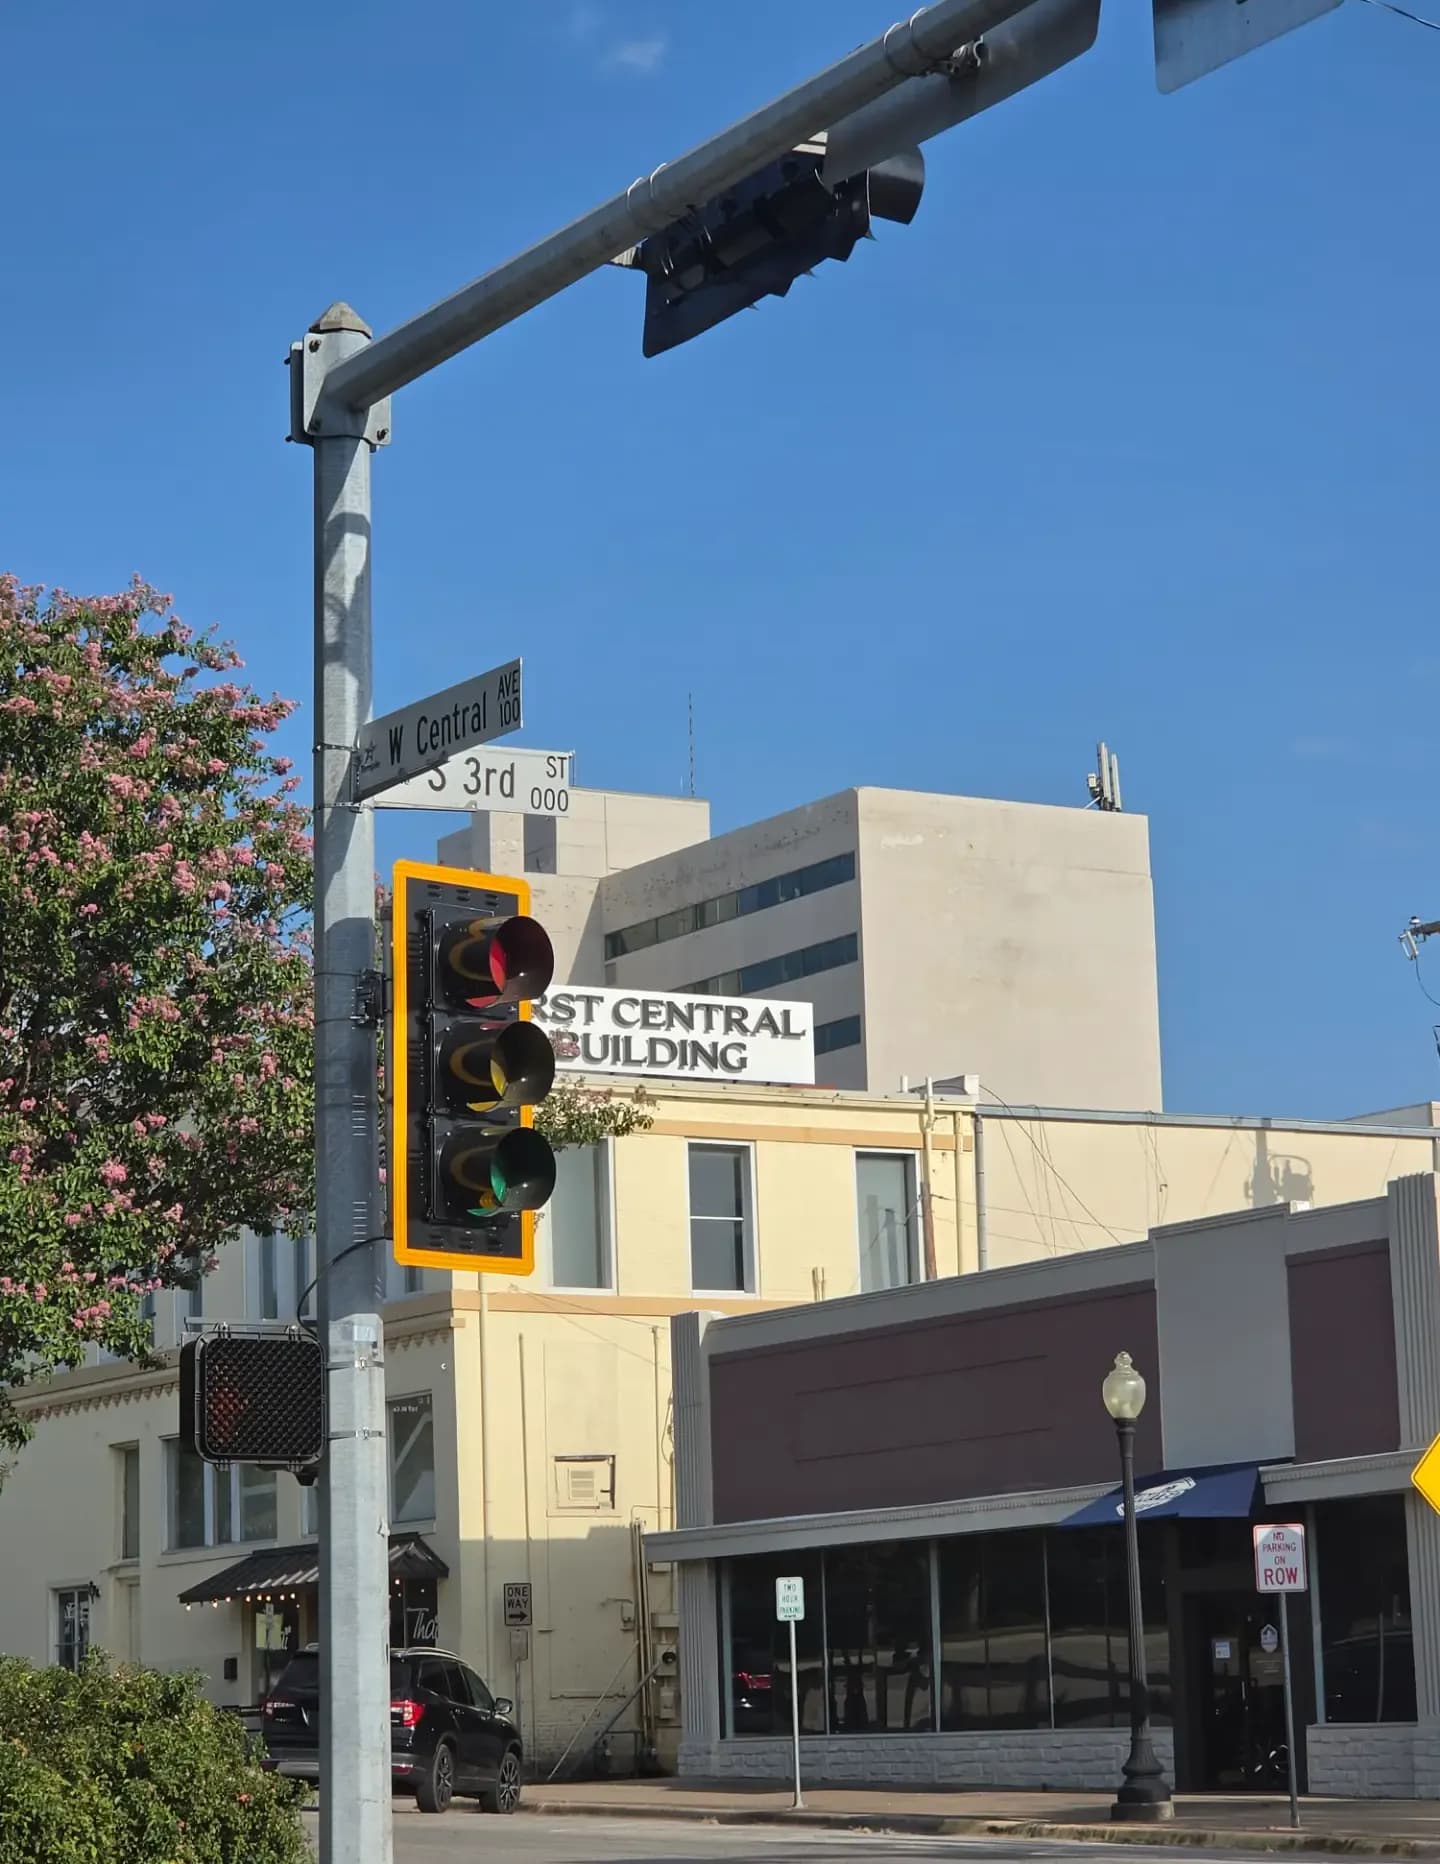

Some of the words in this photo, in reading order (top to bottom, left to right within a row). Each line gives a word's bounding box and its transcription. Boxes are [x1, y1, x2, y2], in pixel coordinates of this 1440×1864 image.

[497, 669, 519, 701] AVE
[500, 696, 520, 728] 100
[388, 723, 403, 766] W
[416, 692, 487, 755] Central
[428, 767, 446, 792] S
[463, 757, 515, 799] 3rd
[546, 755, 568, 780] ST
[530, 786, 569, 812] 000
[531, 992, 604, 1026] RST
[611, 997, 806, 1041] CENTRAL
[1262, 1543, 1297, 1552] PARKING
[1273, 1531, 1285, 1541] NO
[1274, 1555, 1286, 1566] ON
[1263, 1567, 1298, 1586] ROW
[507, 1586, 528, 1598] ONE
[507, 1598, 528, 1609] WAY
